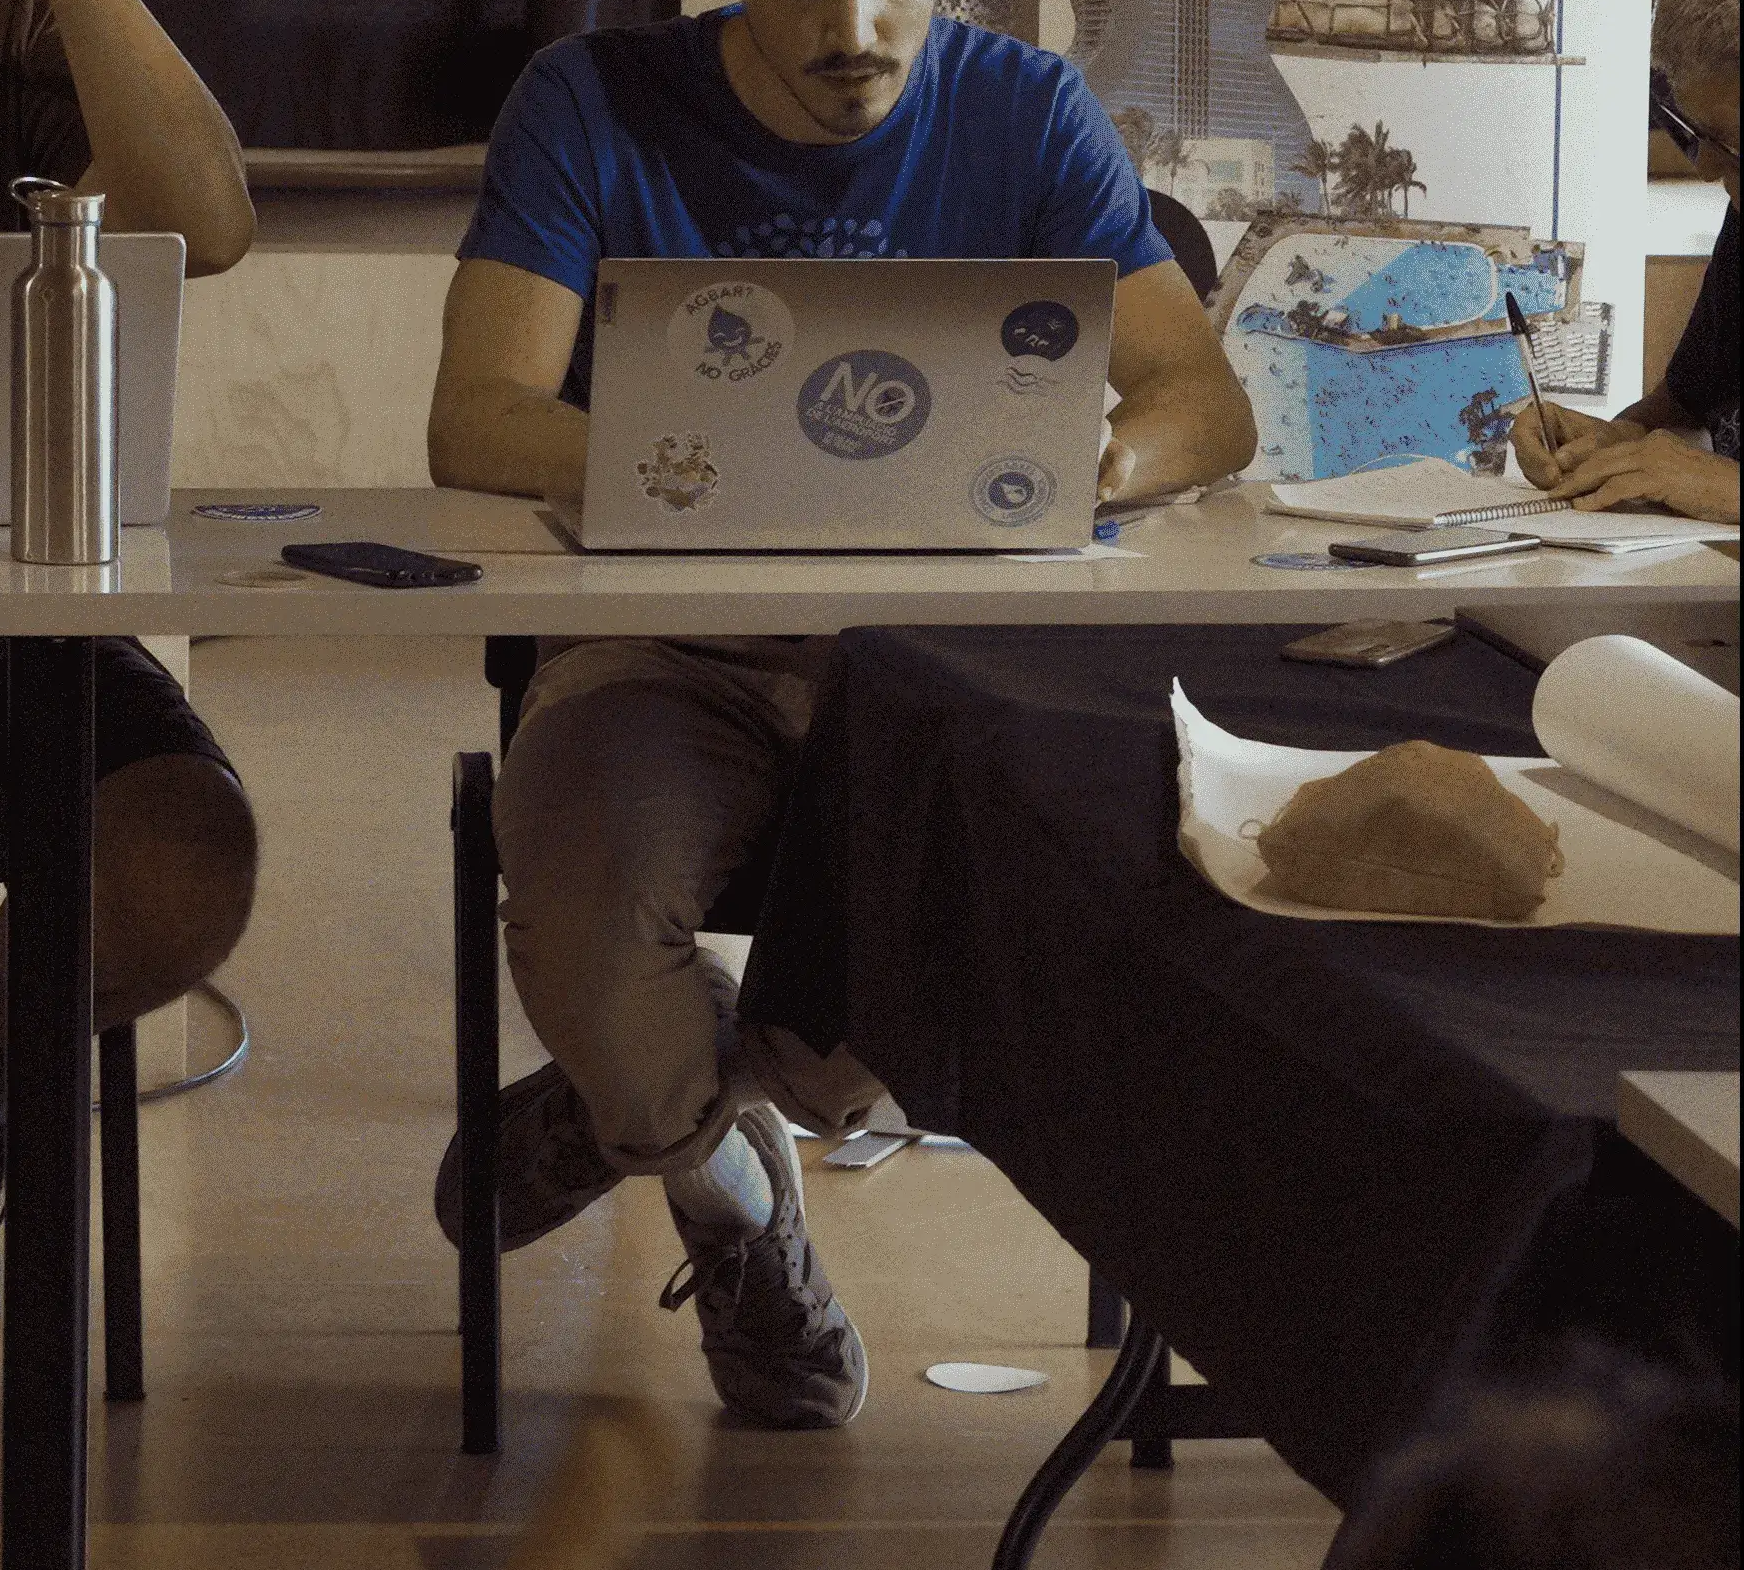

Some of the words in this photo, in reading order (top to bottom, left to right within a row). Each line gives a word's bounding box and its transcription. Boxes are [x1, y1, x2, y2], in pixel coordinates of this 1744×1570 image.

[685, 286, 754, 315] AGBAR?
[695, 361, 722, 380] NO
[820, 361, 916, 425] NO
